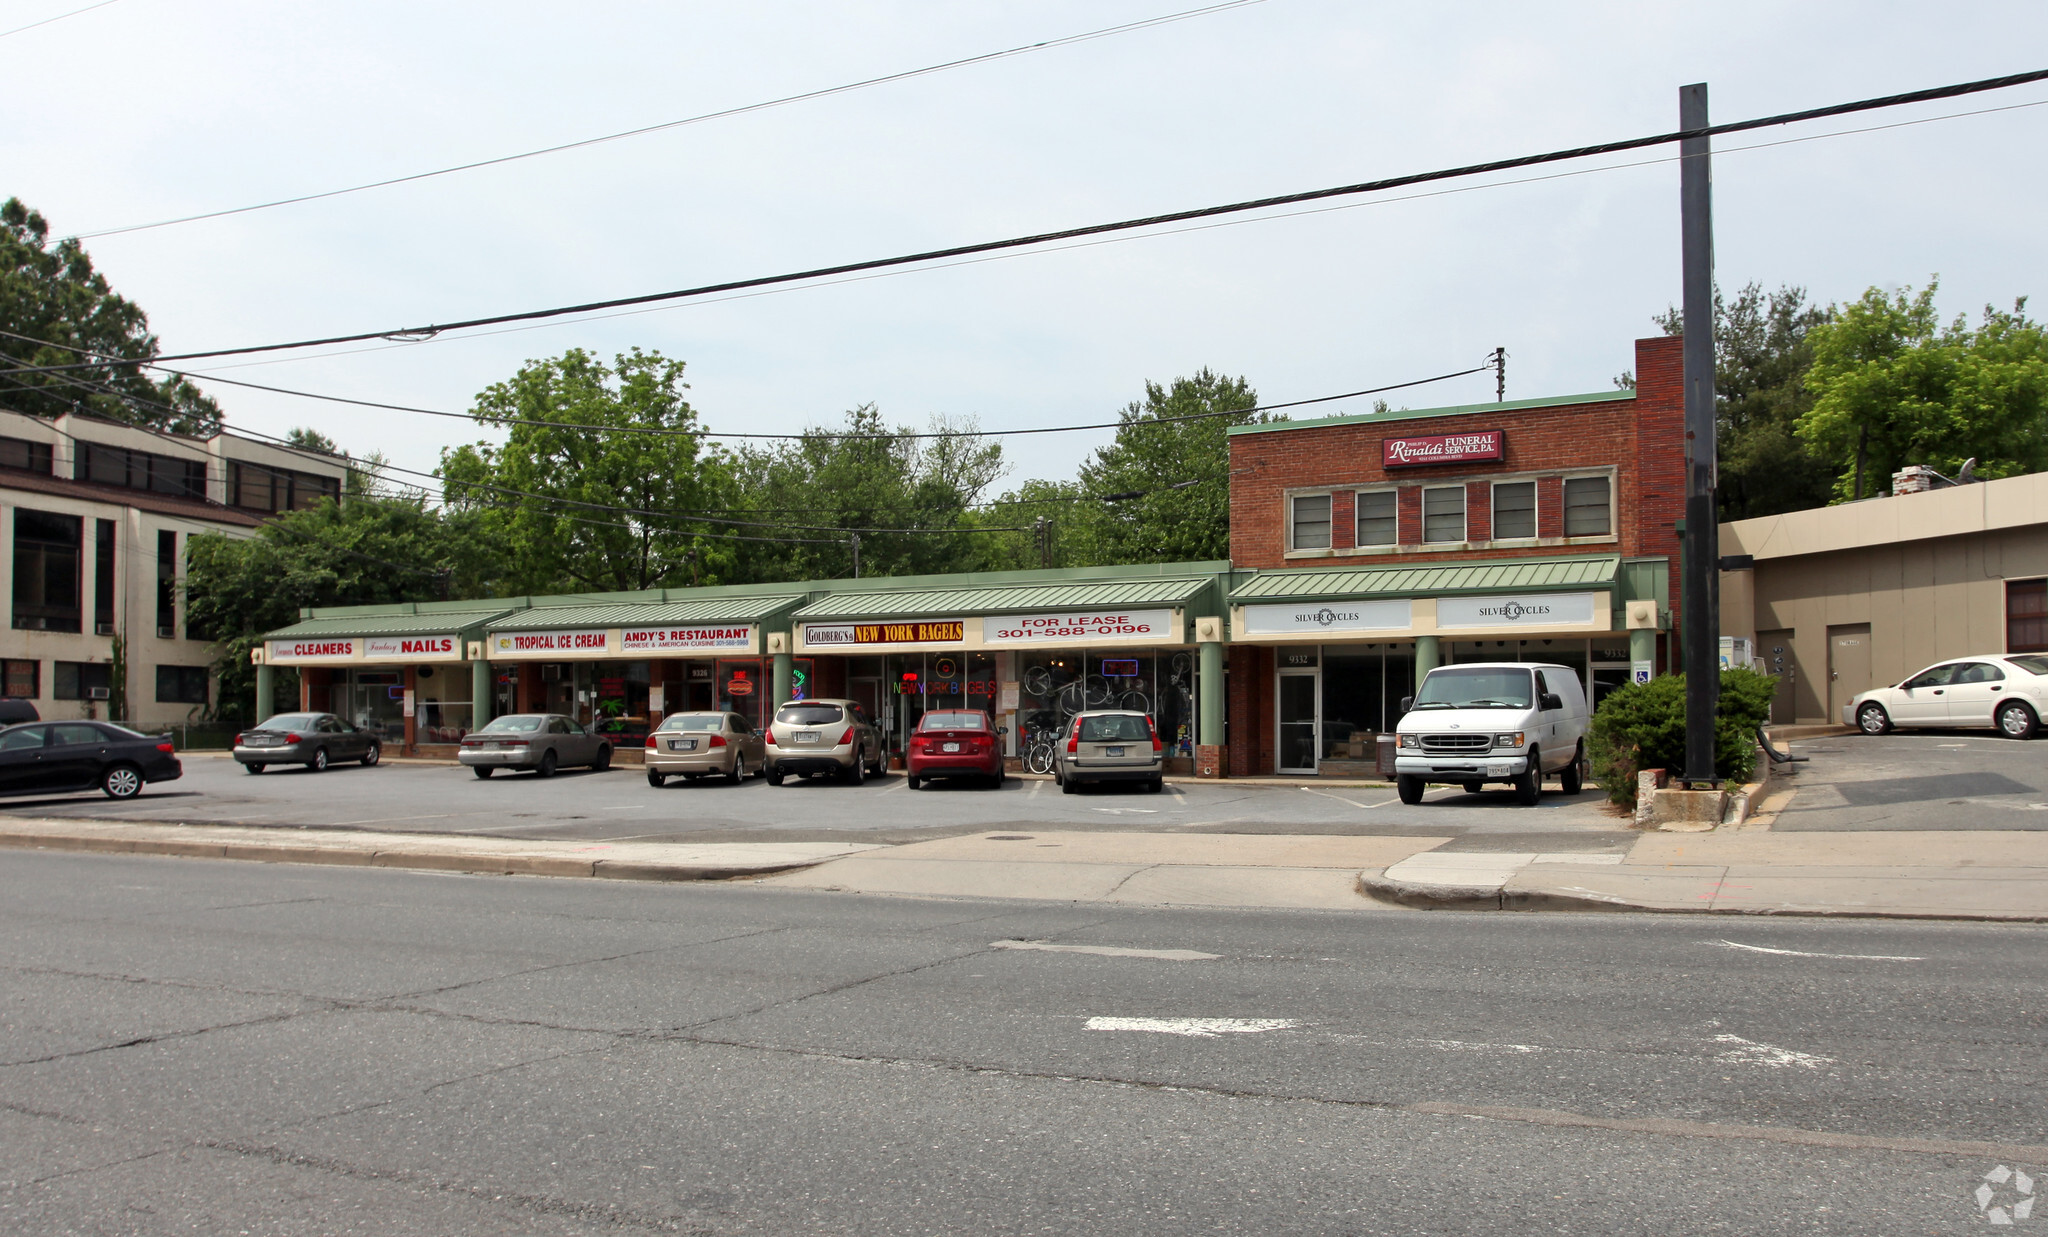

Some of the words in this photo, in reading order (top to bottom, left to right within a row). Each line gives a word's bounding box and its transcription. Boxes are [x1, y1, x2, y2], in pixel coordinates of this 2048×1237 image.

[1445, 435, 1495, 447] FUNERAL
[1389, 441, 1443, 462] Rinaldi
[1445, 444, 1481, 455] SERVICE,
[1479, 607, 1512, 616] SILVER
[1514, 606, 1550, 615] CYCLES
[1022, 619, 1059, 628] FOR
[1068, 616, 1130, 626] LEASE
[1295, 614, 1325, 623] SILVER
[1326, 613, 1359, 622] CYCLES
[624, 631, 666, 641] ANDY'S
[670, 628, 749, 640] RESTAURANT
[855, 626, 880, 642] NEW
[883, 625, 913, 641] YORK
[918, 623, 963, 640] BAGELS
[997, 624, 1151, 638] 301-588-0196
[401, 639, 452, 653] NAILS
[514, 636, 555, 650] TROPICAL
[557, 635, 572, 648] ICE
[574, 634, 606, 647] CREAM
[294, 642, 353, 656] CLEANERS
[1604, 648, 1626, 657] 9332
[1289, 655, 1308, 664] 9332
[692, 669, 708, 677] 9326
[893, 681, 917, 695] NEW
[950, 681, 996, 695] BAGELS
